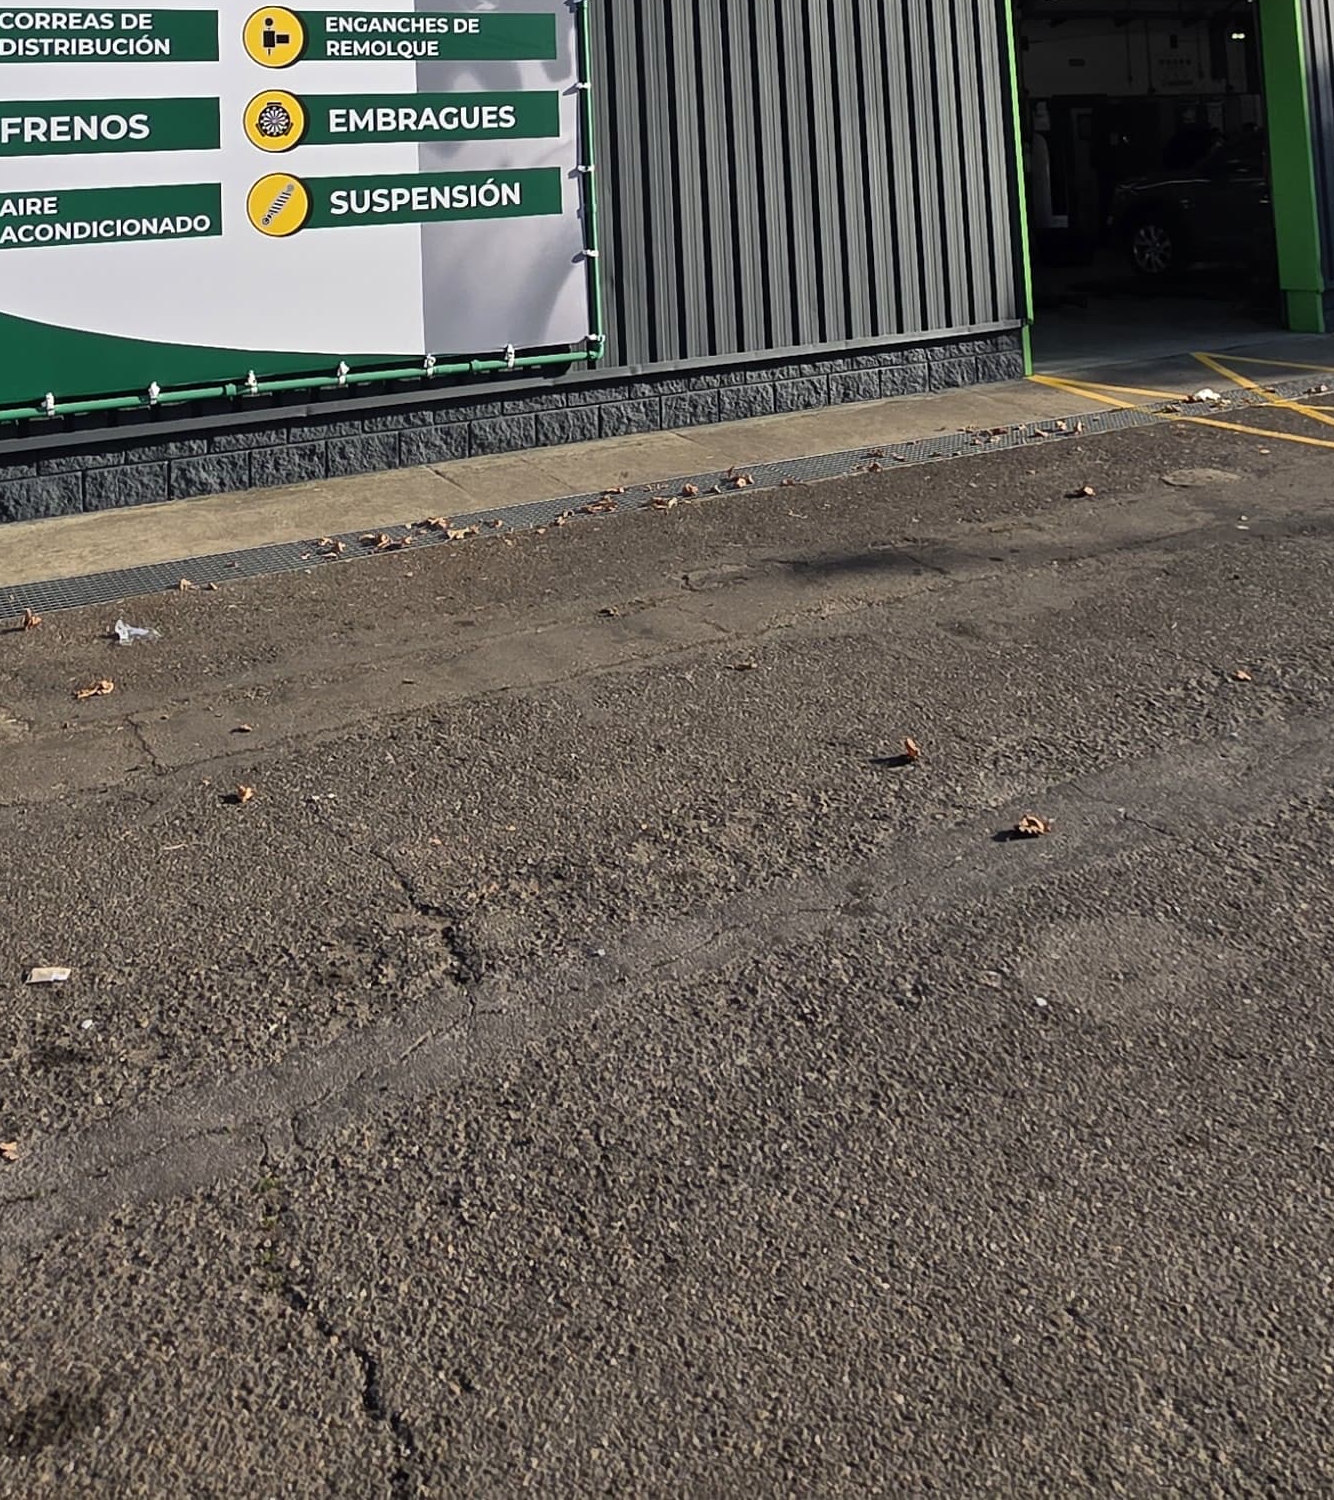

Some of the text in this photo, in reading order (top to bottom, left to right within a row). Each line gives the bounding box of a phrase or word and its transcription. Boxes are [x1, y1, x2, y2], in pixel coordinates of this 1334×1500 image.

[121, 13, 153, 30] DE
[325, 16, 480, 34] ENGANCHES DE
[326, 40, 439, 59] REMOLQUE
[0, 113, 150, 144] FRENOS
[329, 105, 516, 133] EMBRAGUES
[329, 178, 521, 215] SUSPENSIÓN
